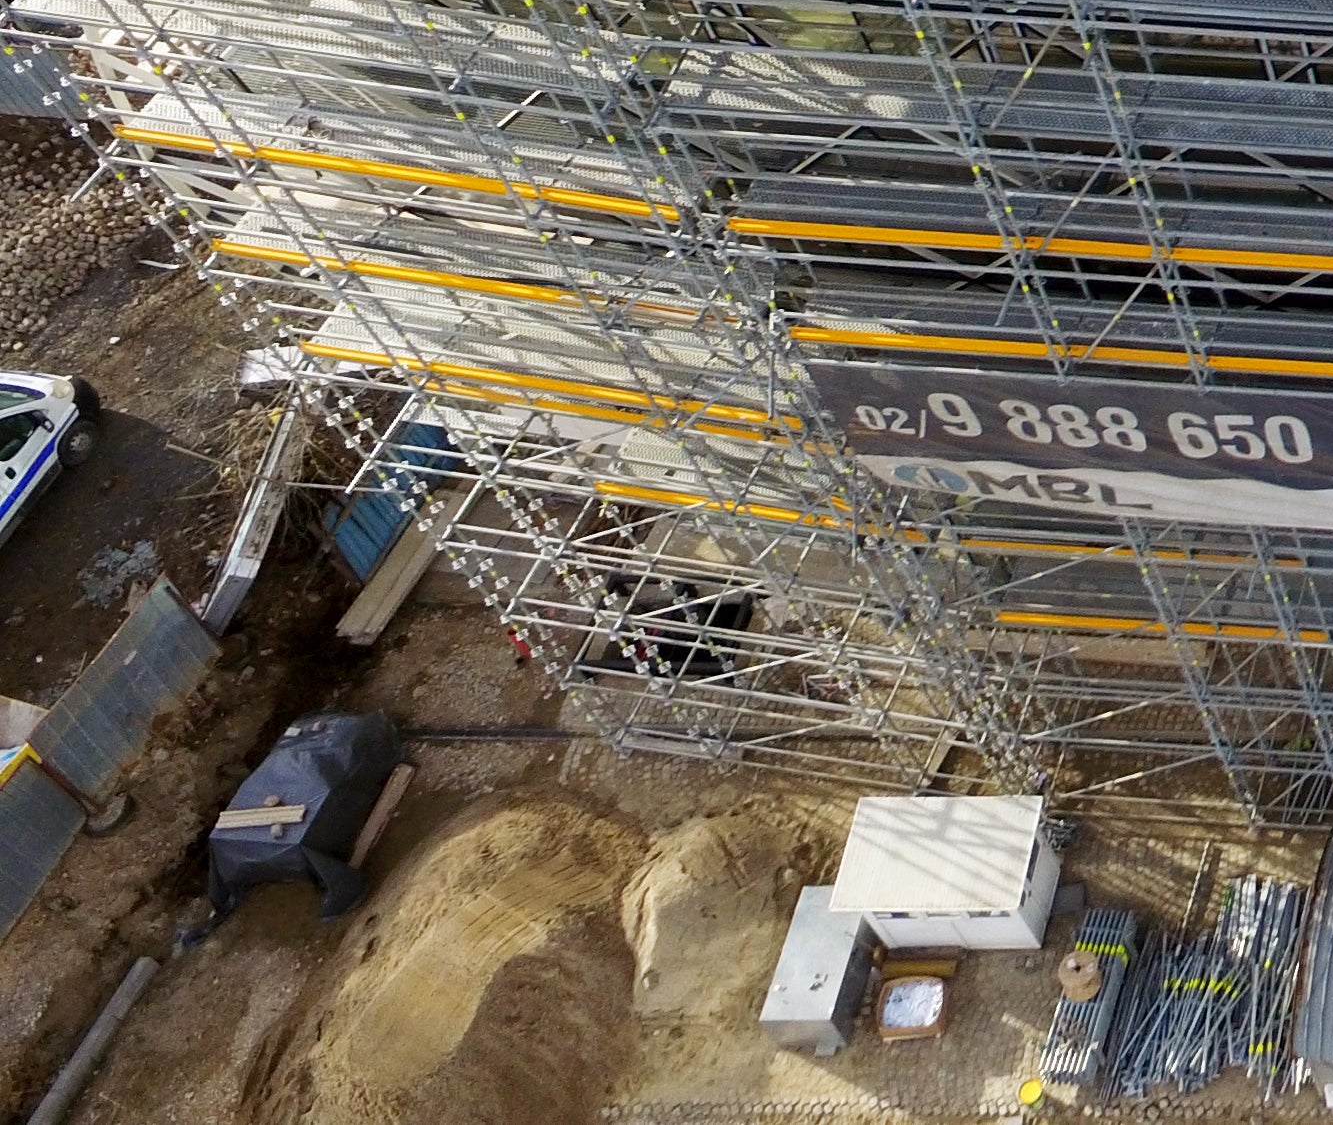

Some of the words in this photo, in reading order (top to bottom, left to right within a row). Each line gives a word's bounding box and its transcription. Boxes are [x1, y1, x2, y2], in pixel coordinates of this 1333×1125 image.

[1000, 398, 1148, 452] 888
[1167, 411, 1314, 463] 650
[966, 469, 1153, 511] MBL
